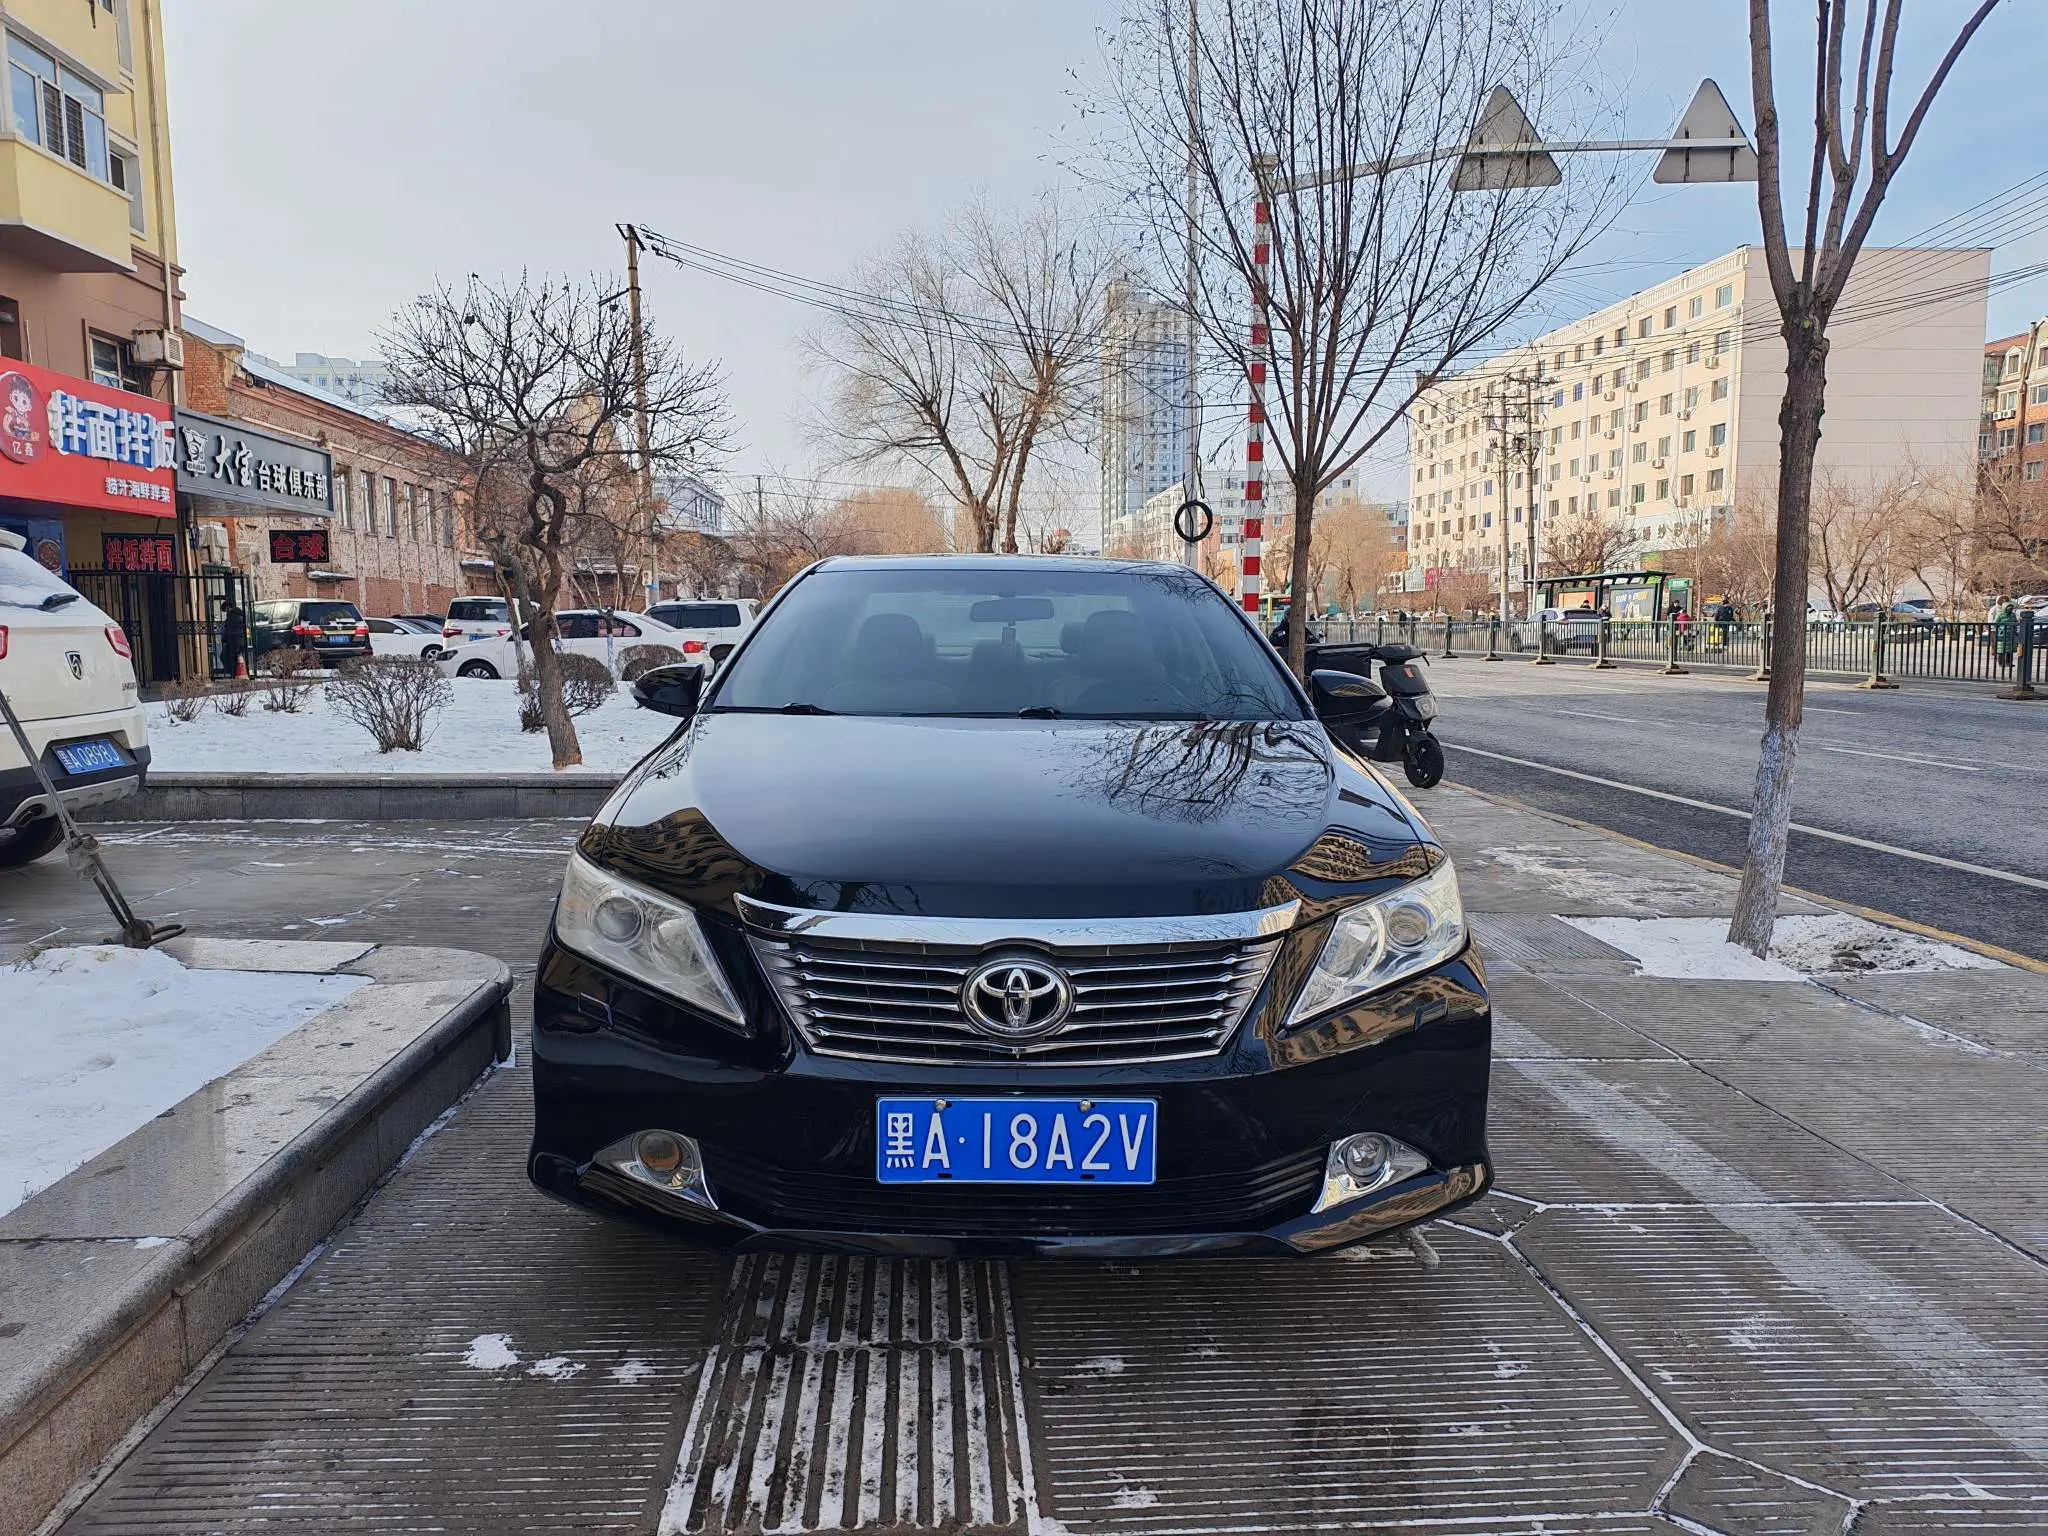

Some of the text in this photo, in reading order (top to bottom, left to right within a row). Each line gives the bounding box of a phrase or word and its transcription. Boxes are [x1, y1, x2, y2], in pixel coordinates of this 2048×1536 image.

[47, 390, 178, 470] 拌面拌饭
[106, 537, 174, 572] 拌饭拌面
[272, 533, 326, 560] 台球
